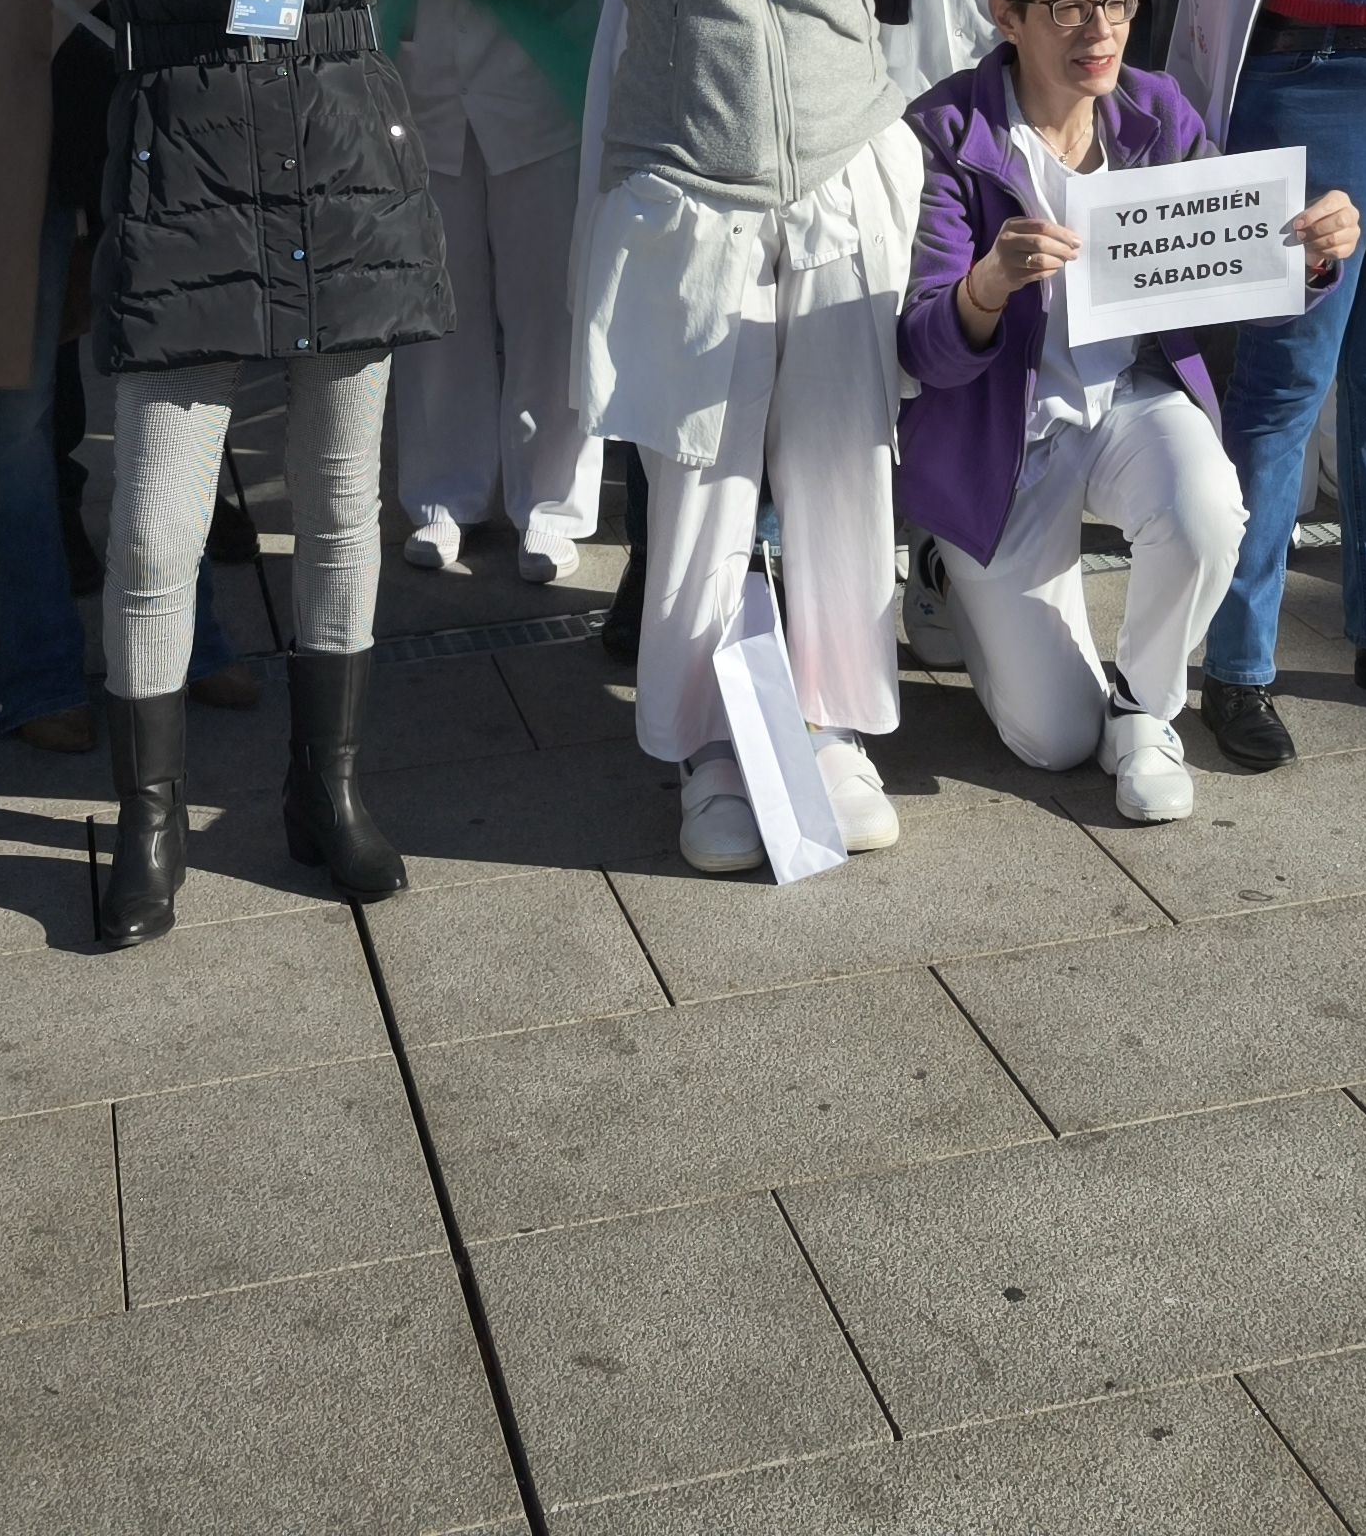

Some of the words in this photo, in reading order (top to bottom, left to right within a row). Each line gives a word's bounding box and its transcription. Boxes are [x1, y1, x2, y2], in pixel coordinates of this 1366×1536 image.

[1115, 208, 1148, 227] YO
[1155, 189, 1261, 221] TAMBIÉN
[1107, 228, 1217, 261] TRABAJO
[1223, 221, 1269, 244] LOS
[1133, 258, 1244, 290] SÁBADOS
